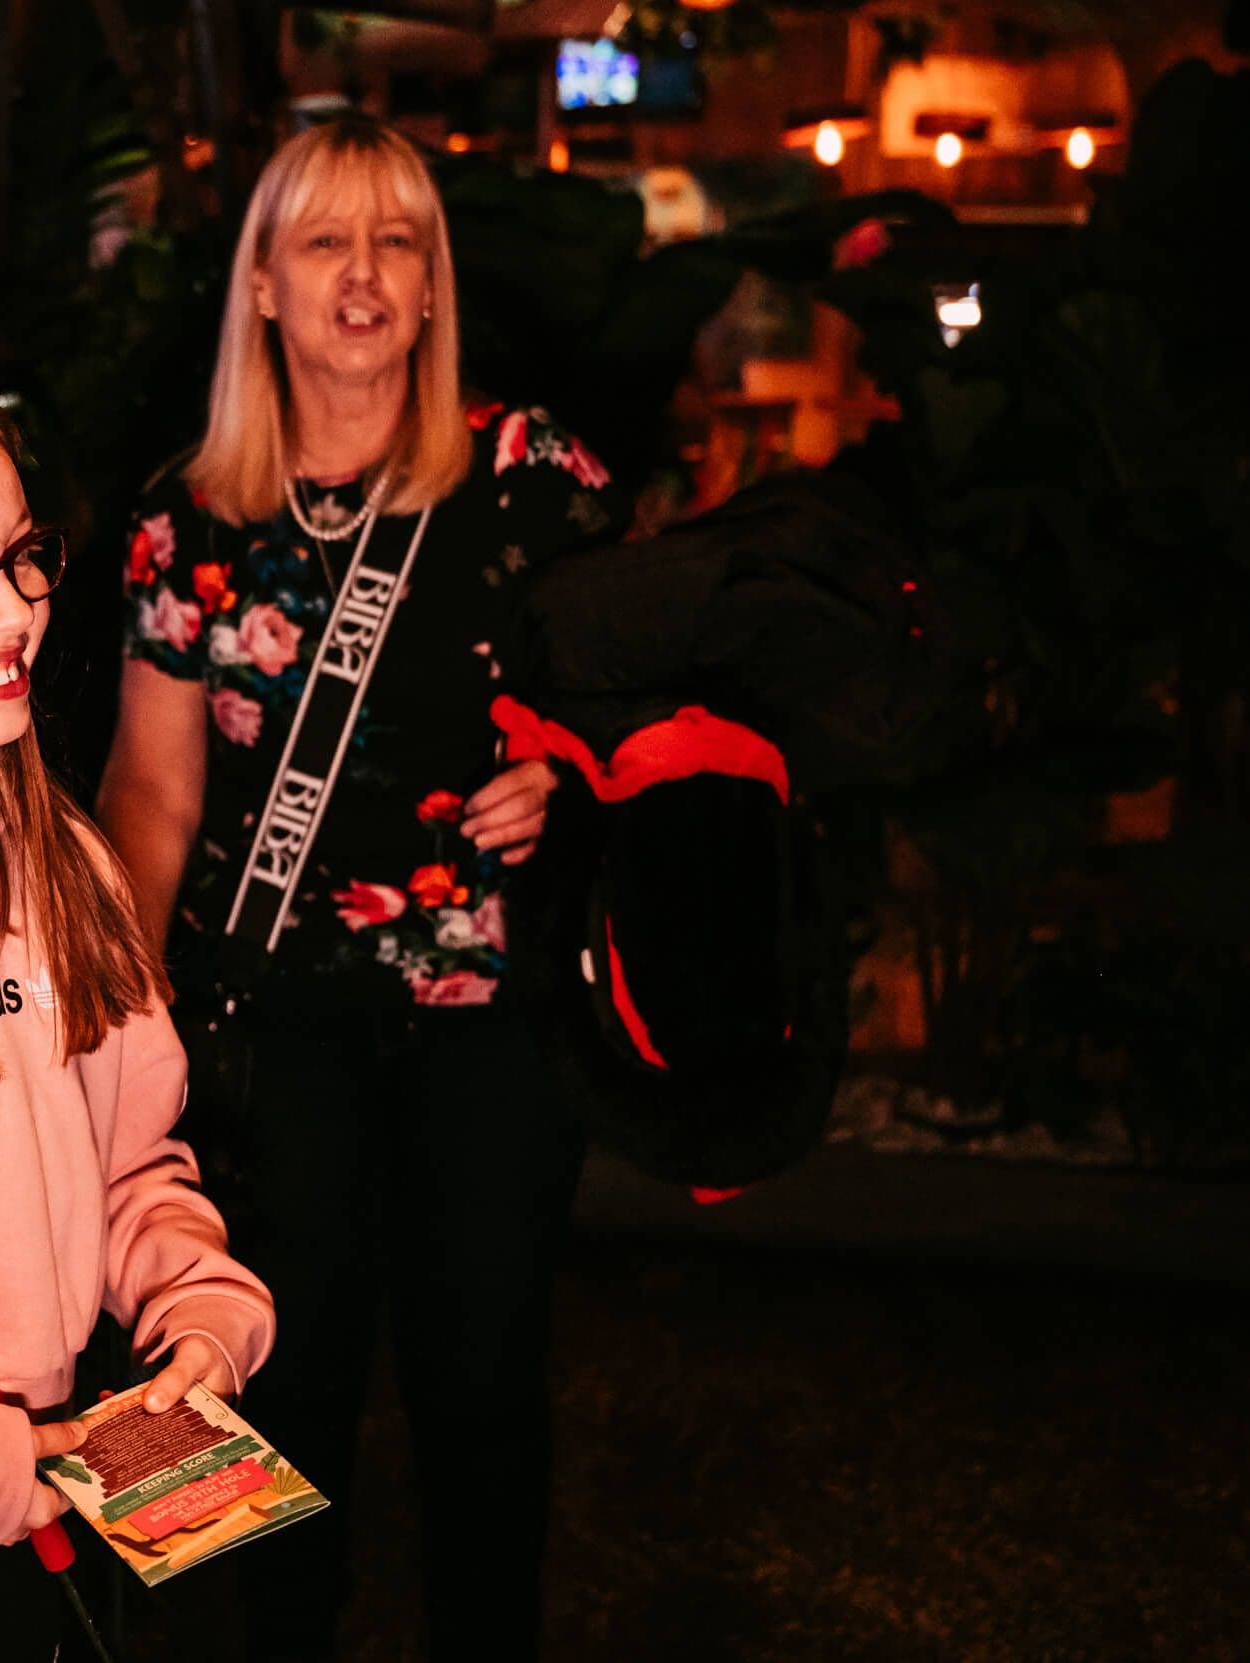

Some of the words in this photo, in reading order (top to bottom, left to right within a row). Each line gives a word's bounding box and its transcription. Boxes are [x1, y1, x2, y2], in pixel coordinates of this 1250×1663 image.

[321, 564, 398, 685] BIBA
[252, 768, 327, 890] BIBA
[137, 1468, 183, 1494] KEEPING
[183, 1452, 215, 1470] SCORE
[220, 1470, 251, 1487] HOLE
